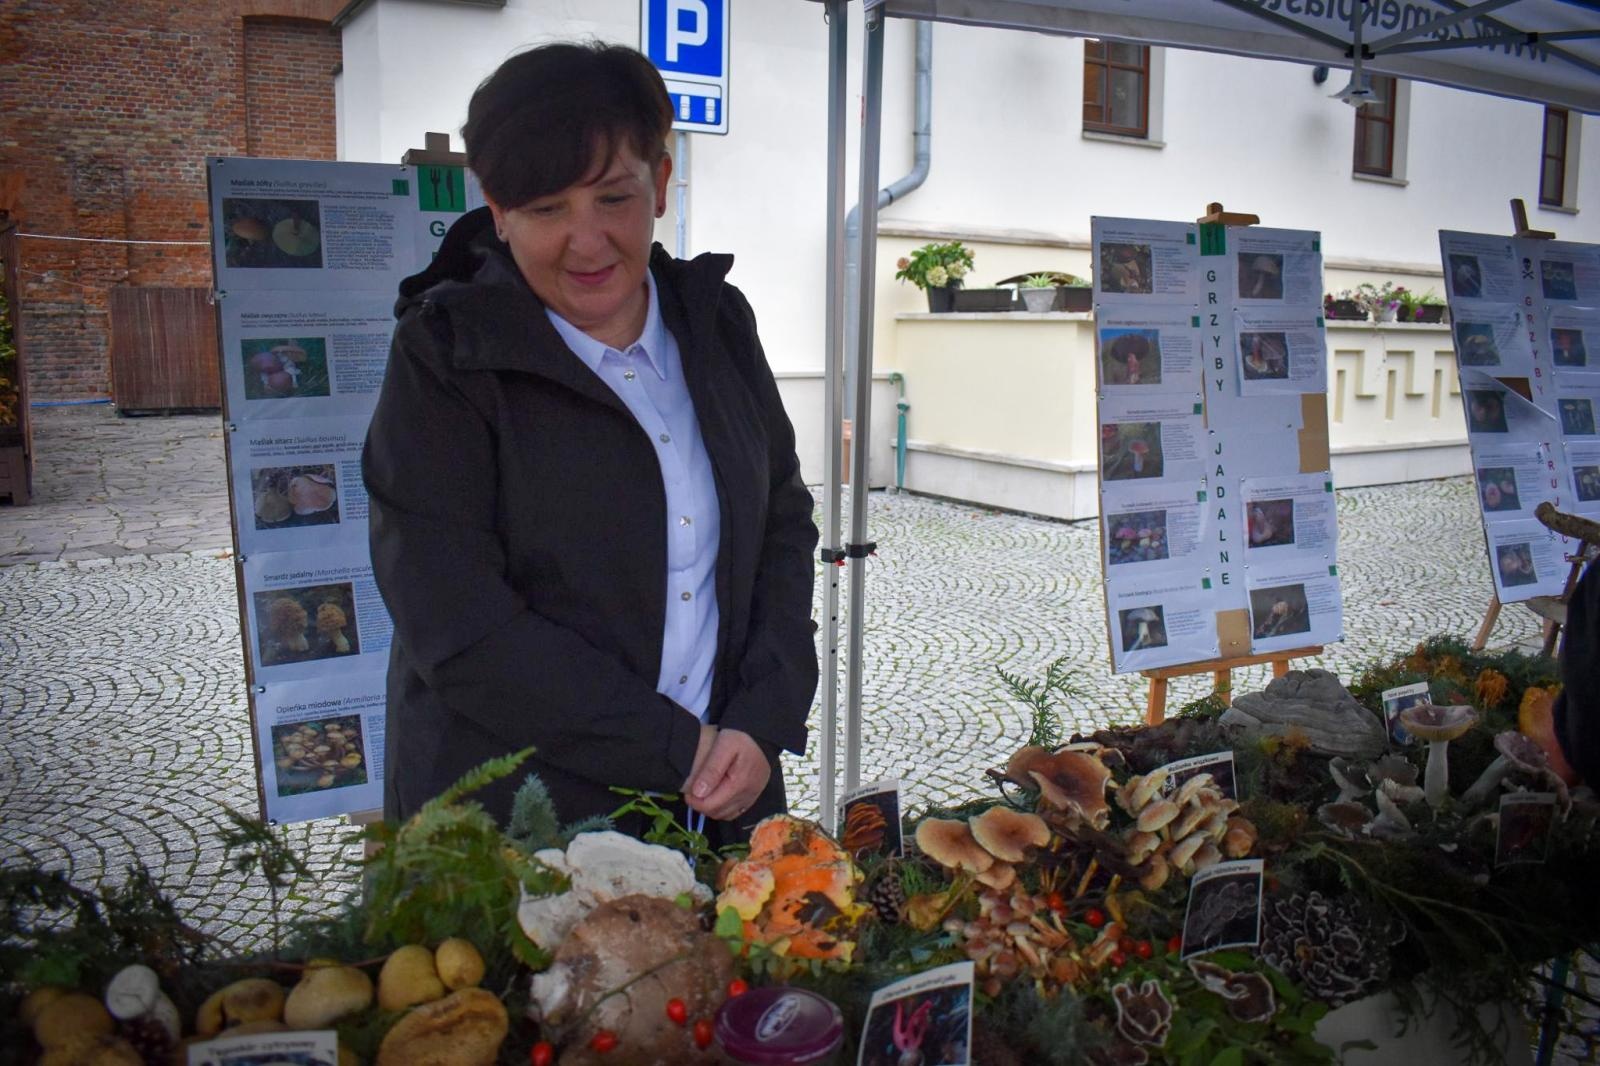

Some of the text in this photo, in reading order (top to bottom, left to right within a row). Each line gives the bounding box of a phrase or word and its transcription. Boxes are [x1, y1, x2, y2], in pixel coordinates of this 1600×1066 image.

[666, 0, 709, 62] P
[1206, 269, 1230, 585] GRZYBY JADALNE
[1524, 296, 1569, 563] GRZYBY TRUJCE
[308, 699, 342, 710] miodowa
